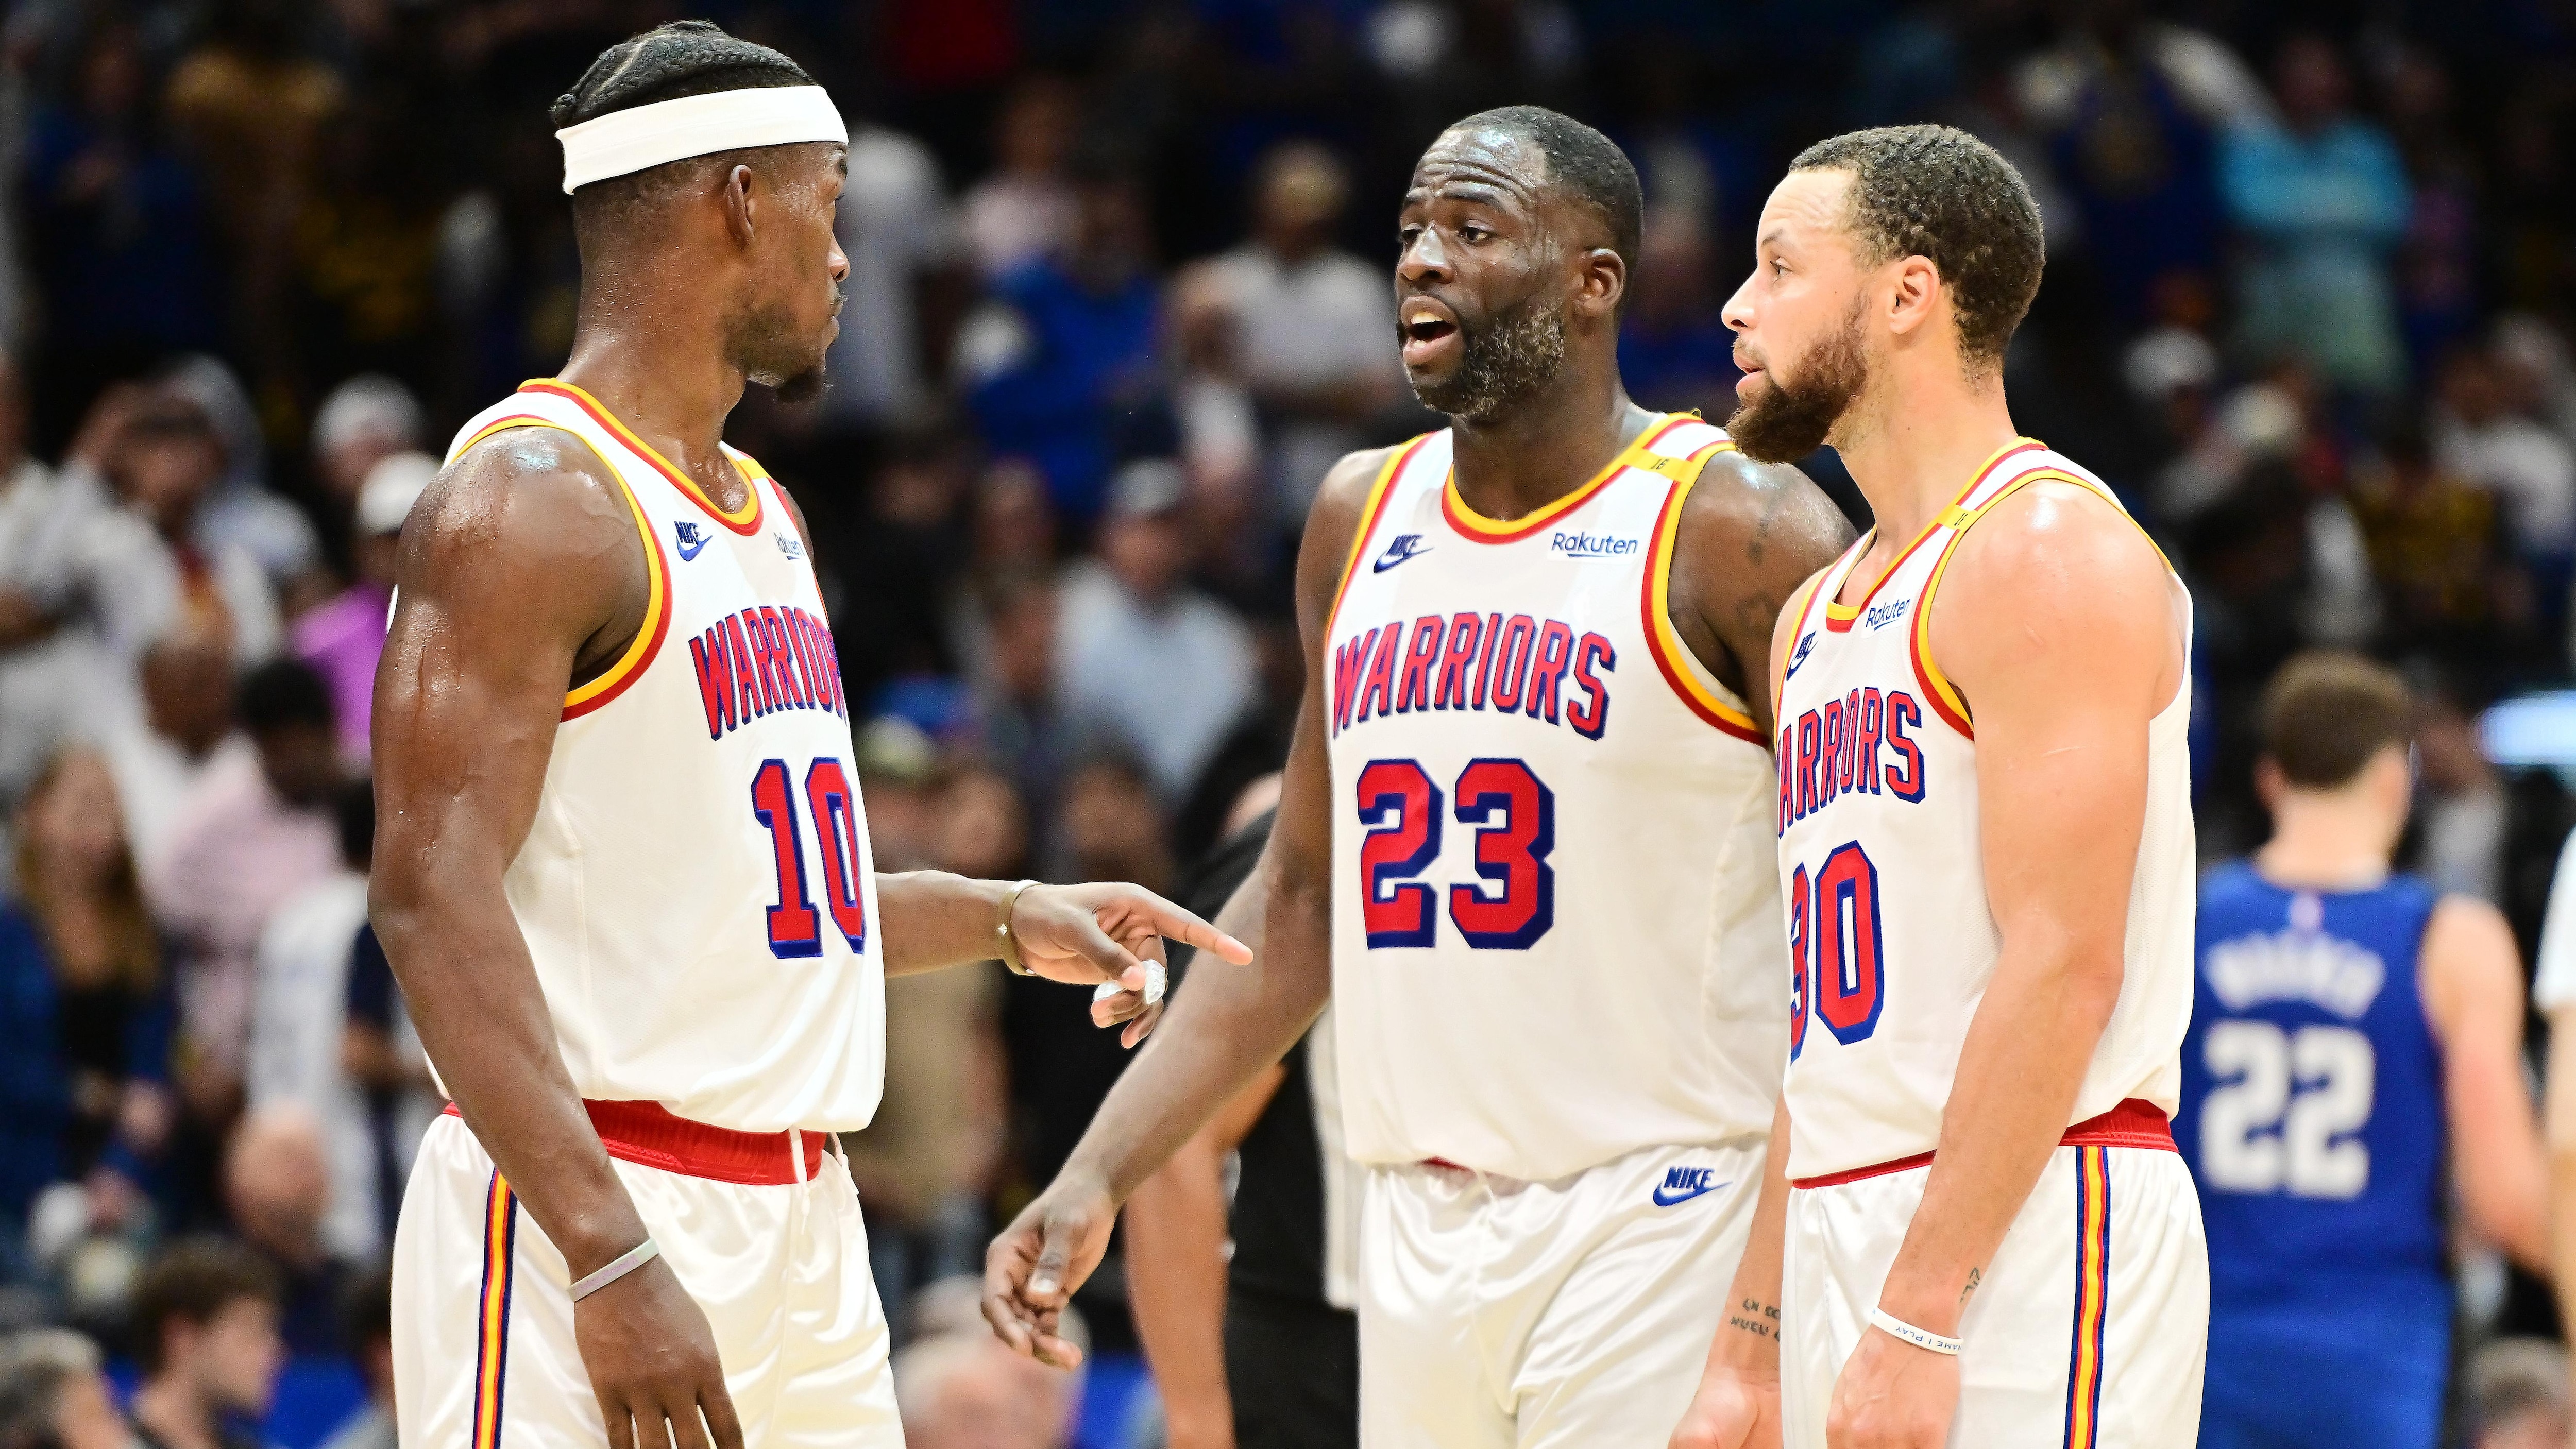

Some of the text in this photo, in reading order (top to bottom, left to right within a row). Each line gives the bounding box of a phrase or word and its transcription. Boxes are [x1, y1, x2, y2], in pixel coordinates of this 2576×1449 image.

[773, 531, 805, 556] Rakuten
[1551, 531, 1639, 554] Rakuten
[1866, 599, 1910, 627] Rakuten
[1333, 611, 1616, 741] WARRIORS
[751, 757, 866, 959] 10
[1356, 758, 1556, 950] 23
[2200, 1019, 2375, 1200] 22
[1664, 1166, 1715, 1189] NIKE
[1896, 1326, 1924, 1342] PLAY
